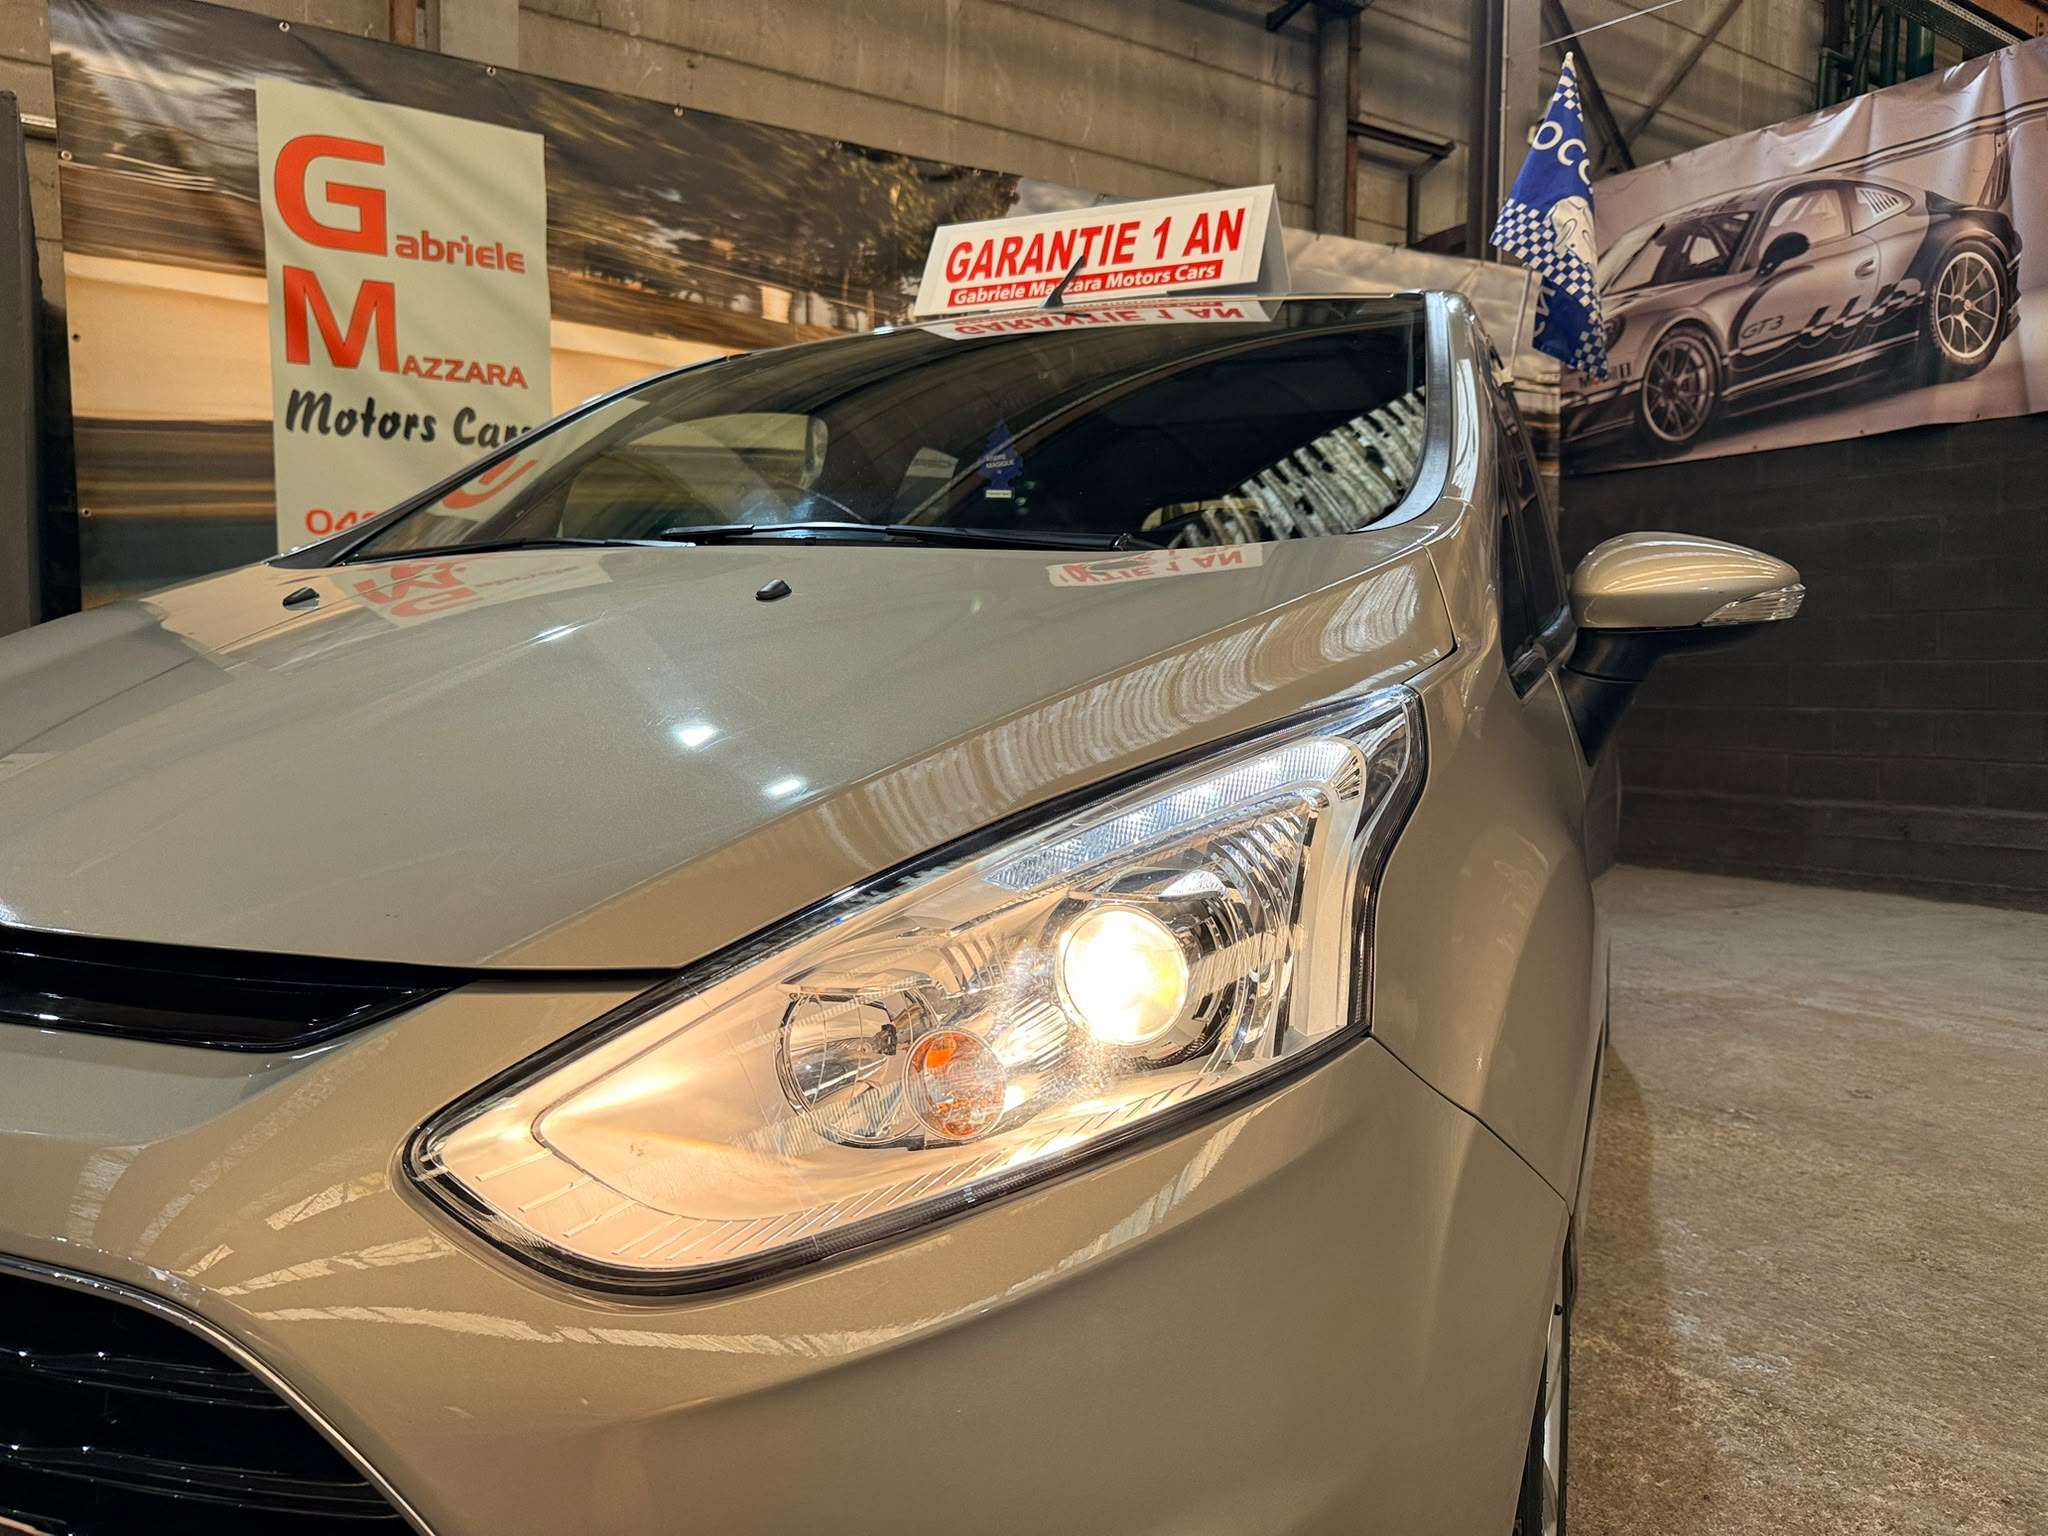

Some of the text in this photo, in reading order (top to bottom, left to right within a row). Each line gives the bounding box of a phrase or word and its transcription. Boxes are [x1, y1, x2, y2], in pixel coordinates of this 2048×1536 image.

[274, 134, 527, 275] Gabriele
[945, 207, 1246, 284] GARANTIE 1 AN
[953, 263, 1216, 305] Gabriele Mazara Motors Cars
[283, 264, 528, 389] MAZZARA
[1741, 315, 1784, 340] GT3
[285, 388, 437, 441] Motors
